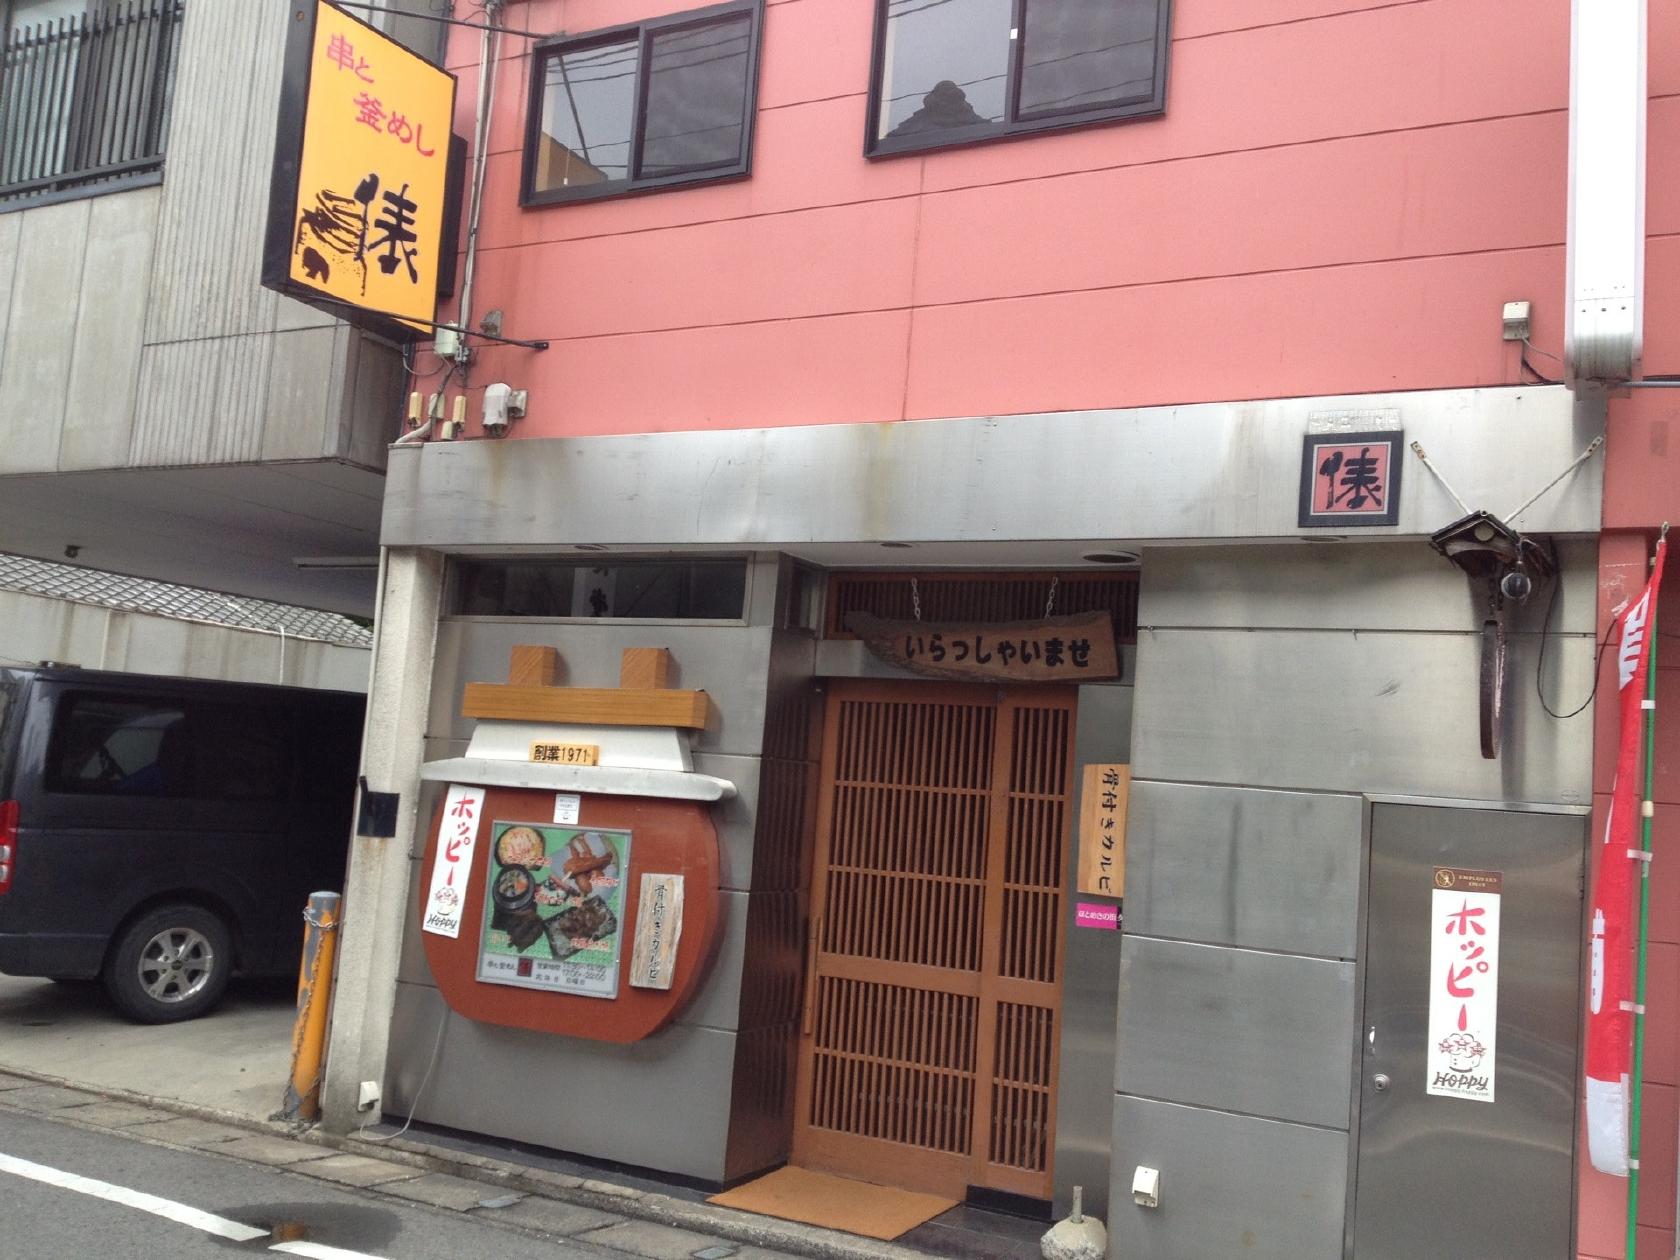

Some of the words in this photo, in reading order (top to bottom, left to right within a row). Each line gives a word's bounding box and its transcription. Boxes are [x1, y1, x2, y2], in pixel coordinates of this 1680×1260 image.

[326, 32, 375, 84] 串と
[353, 91, 435, 157] 釜めし
[1319, 446, 1382, 510] 俵
[905, 633, 1091, 668] いらっしゃいませ
[533, 744, 588, 763] 創業1971
[444, 790, 476, 886] ホッピー
[1098, 768, 1119, 895] 骨付きカルビ
[1445, 898, 1489, 1032] ホッピー
